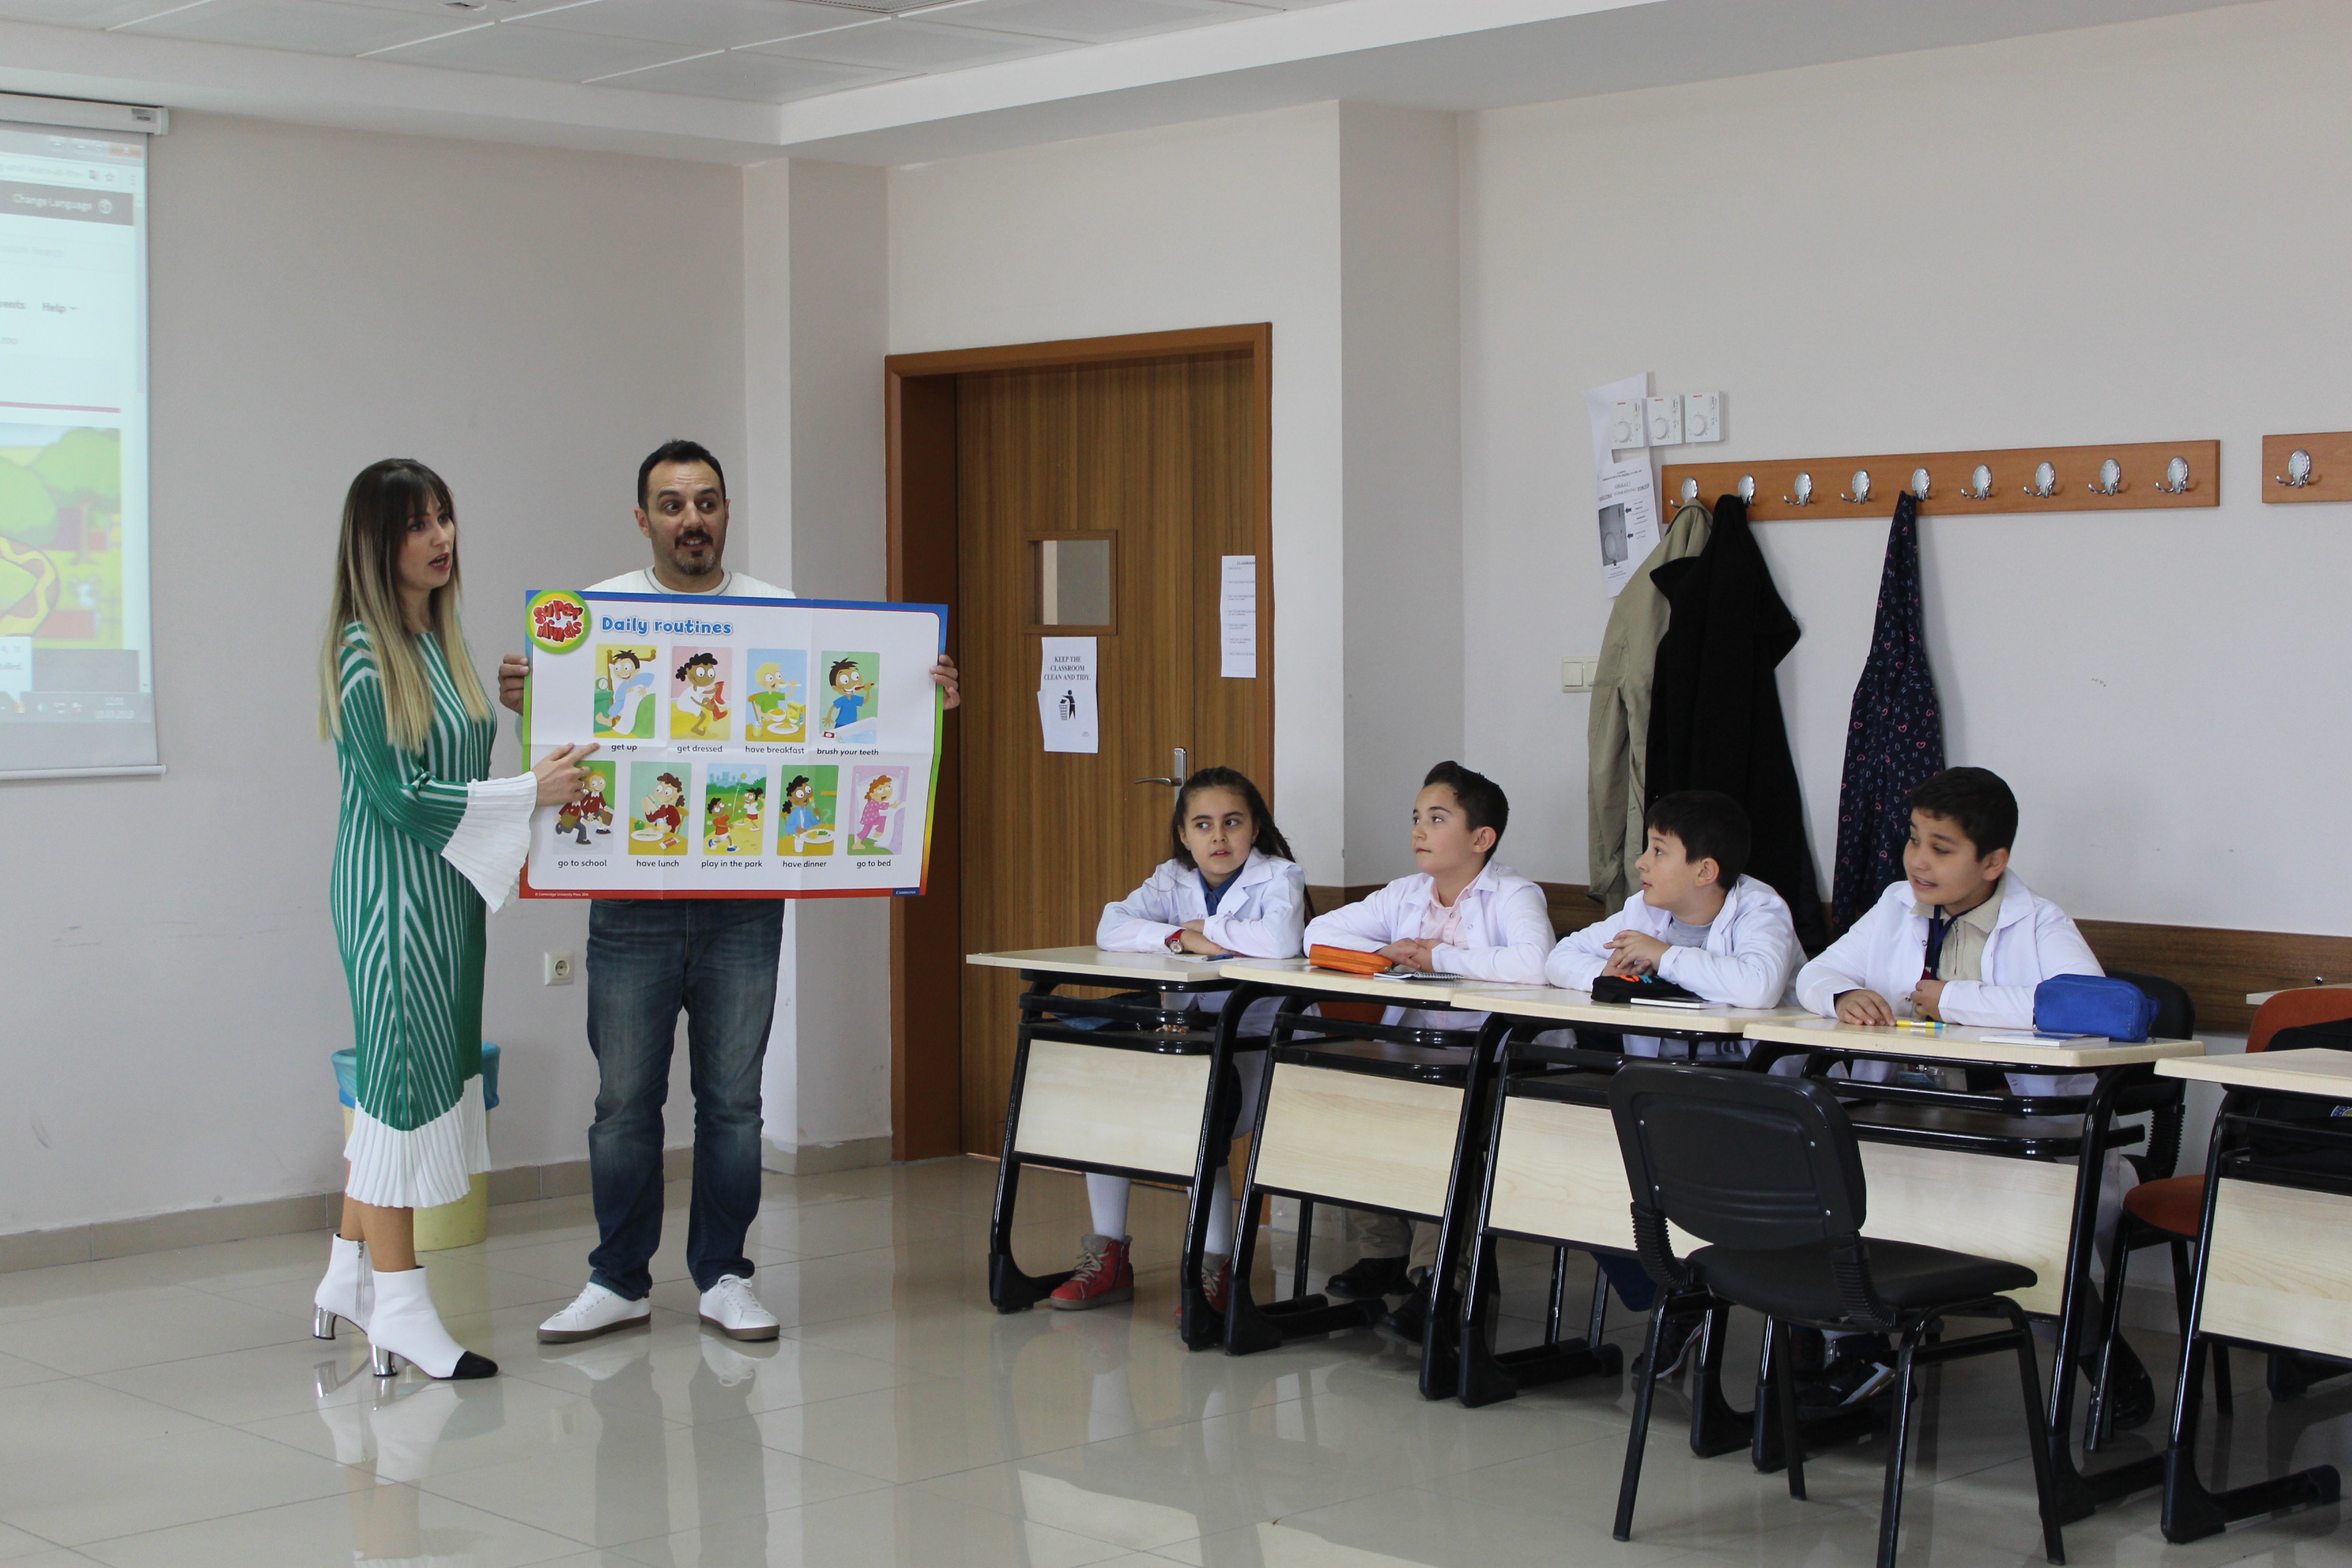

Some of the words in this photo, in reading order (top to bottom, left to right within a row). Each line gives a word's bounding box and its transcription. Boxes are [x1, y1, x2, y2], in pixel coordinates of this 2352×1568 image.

[42, 302, 67, 314] Help
[602, 617, 647, 634] Daily
[654, 620, 732, 634] routines
[701, 860, 719, 868] play
[744, 860, 762, 868] park
